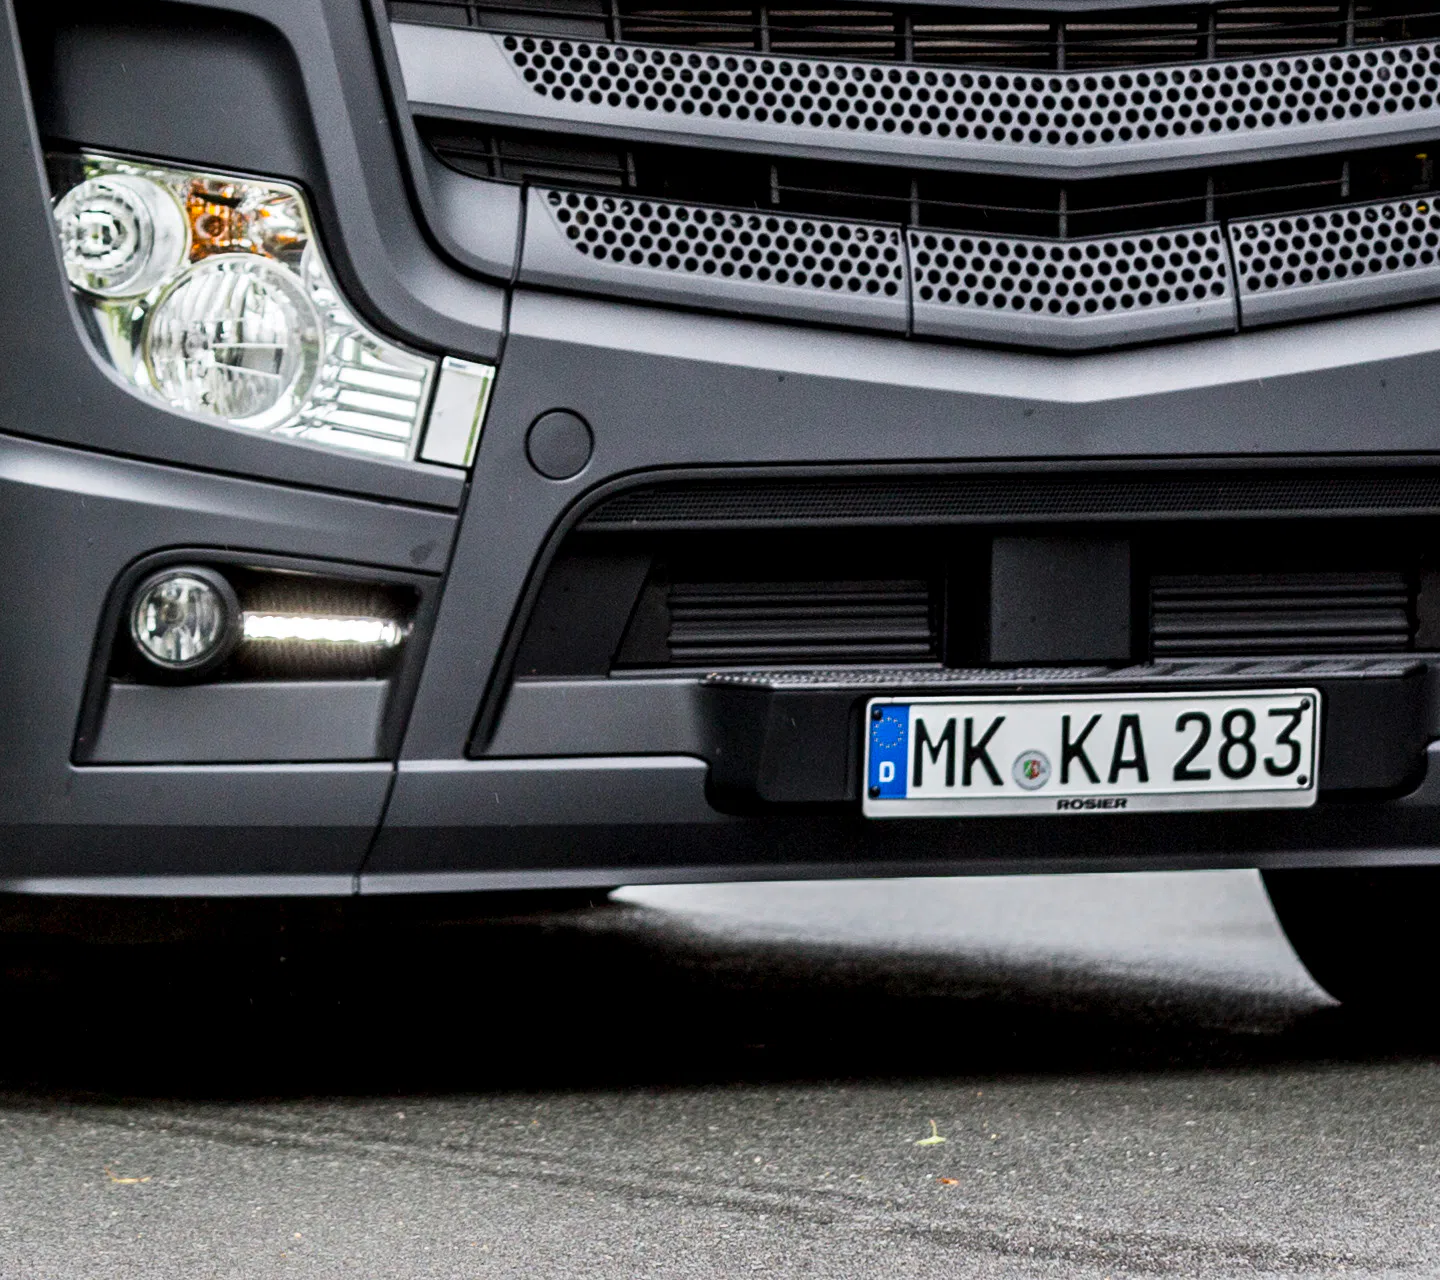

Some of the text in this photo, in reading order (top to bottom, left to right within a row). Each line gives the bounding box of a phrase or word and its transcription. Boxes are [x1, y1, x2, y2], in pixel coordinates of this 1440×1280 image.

[878, 706, 1303, 789] D MK KA 283
[1056, 797, 1129, 811] ROSIER
